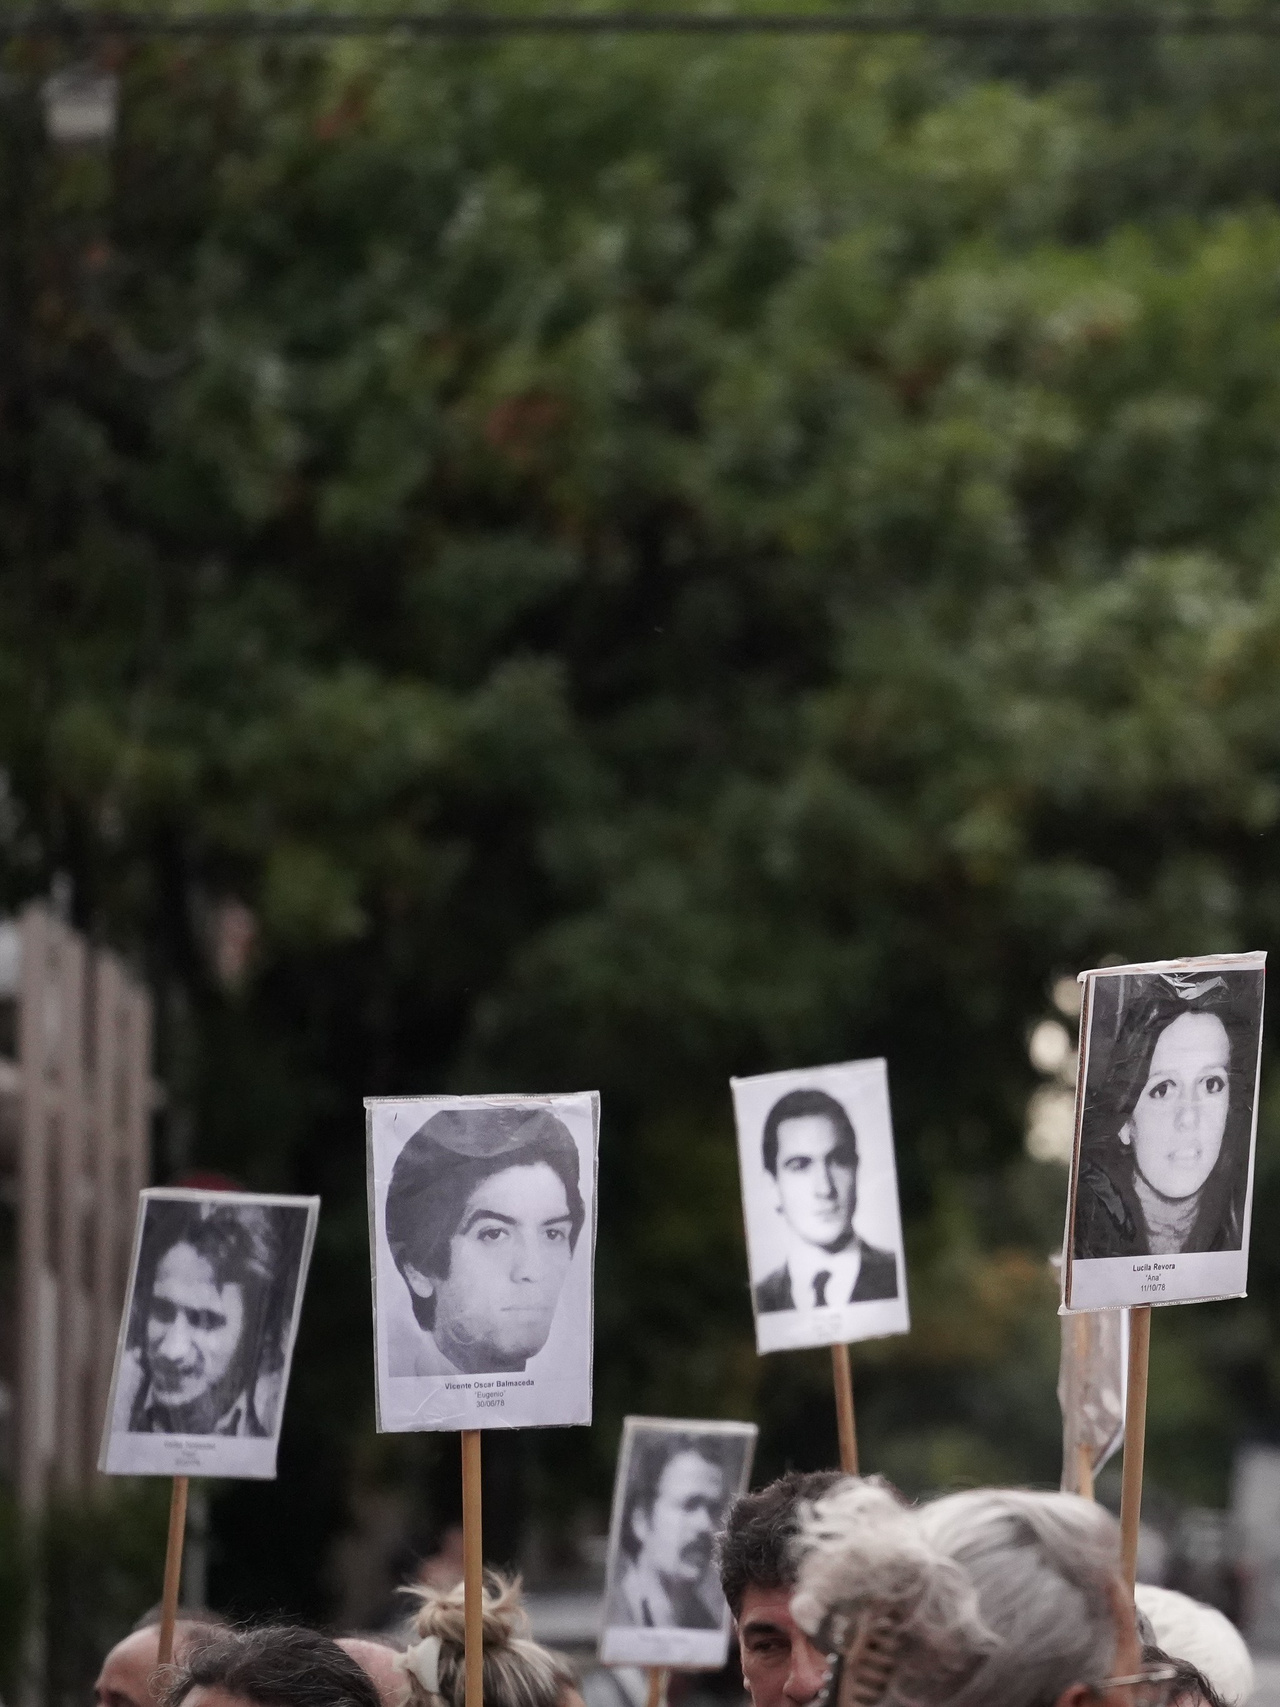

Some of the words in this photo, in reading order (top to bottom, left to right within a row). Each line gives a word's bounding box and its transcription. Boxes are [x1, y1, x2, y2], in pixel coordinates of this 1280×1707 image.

[1132, 1264, 1151, 1272] Lucila
[1153, 1263, 1176, 1271] Revora
[1141, 1283, 1166, 1292] 11/10/78
[444, 1382, 472, 1390] Vicente
[473, 1381, 494, 1389] Oscar
[496, 1379, 535, 1388] Balmaceda
